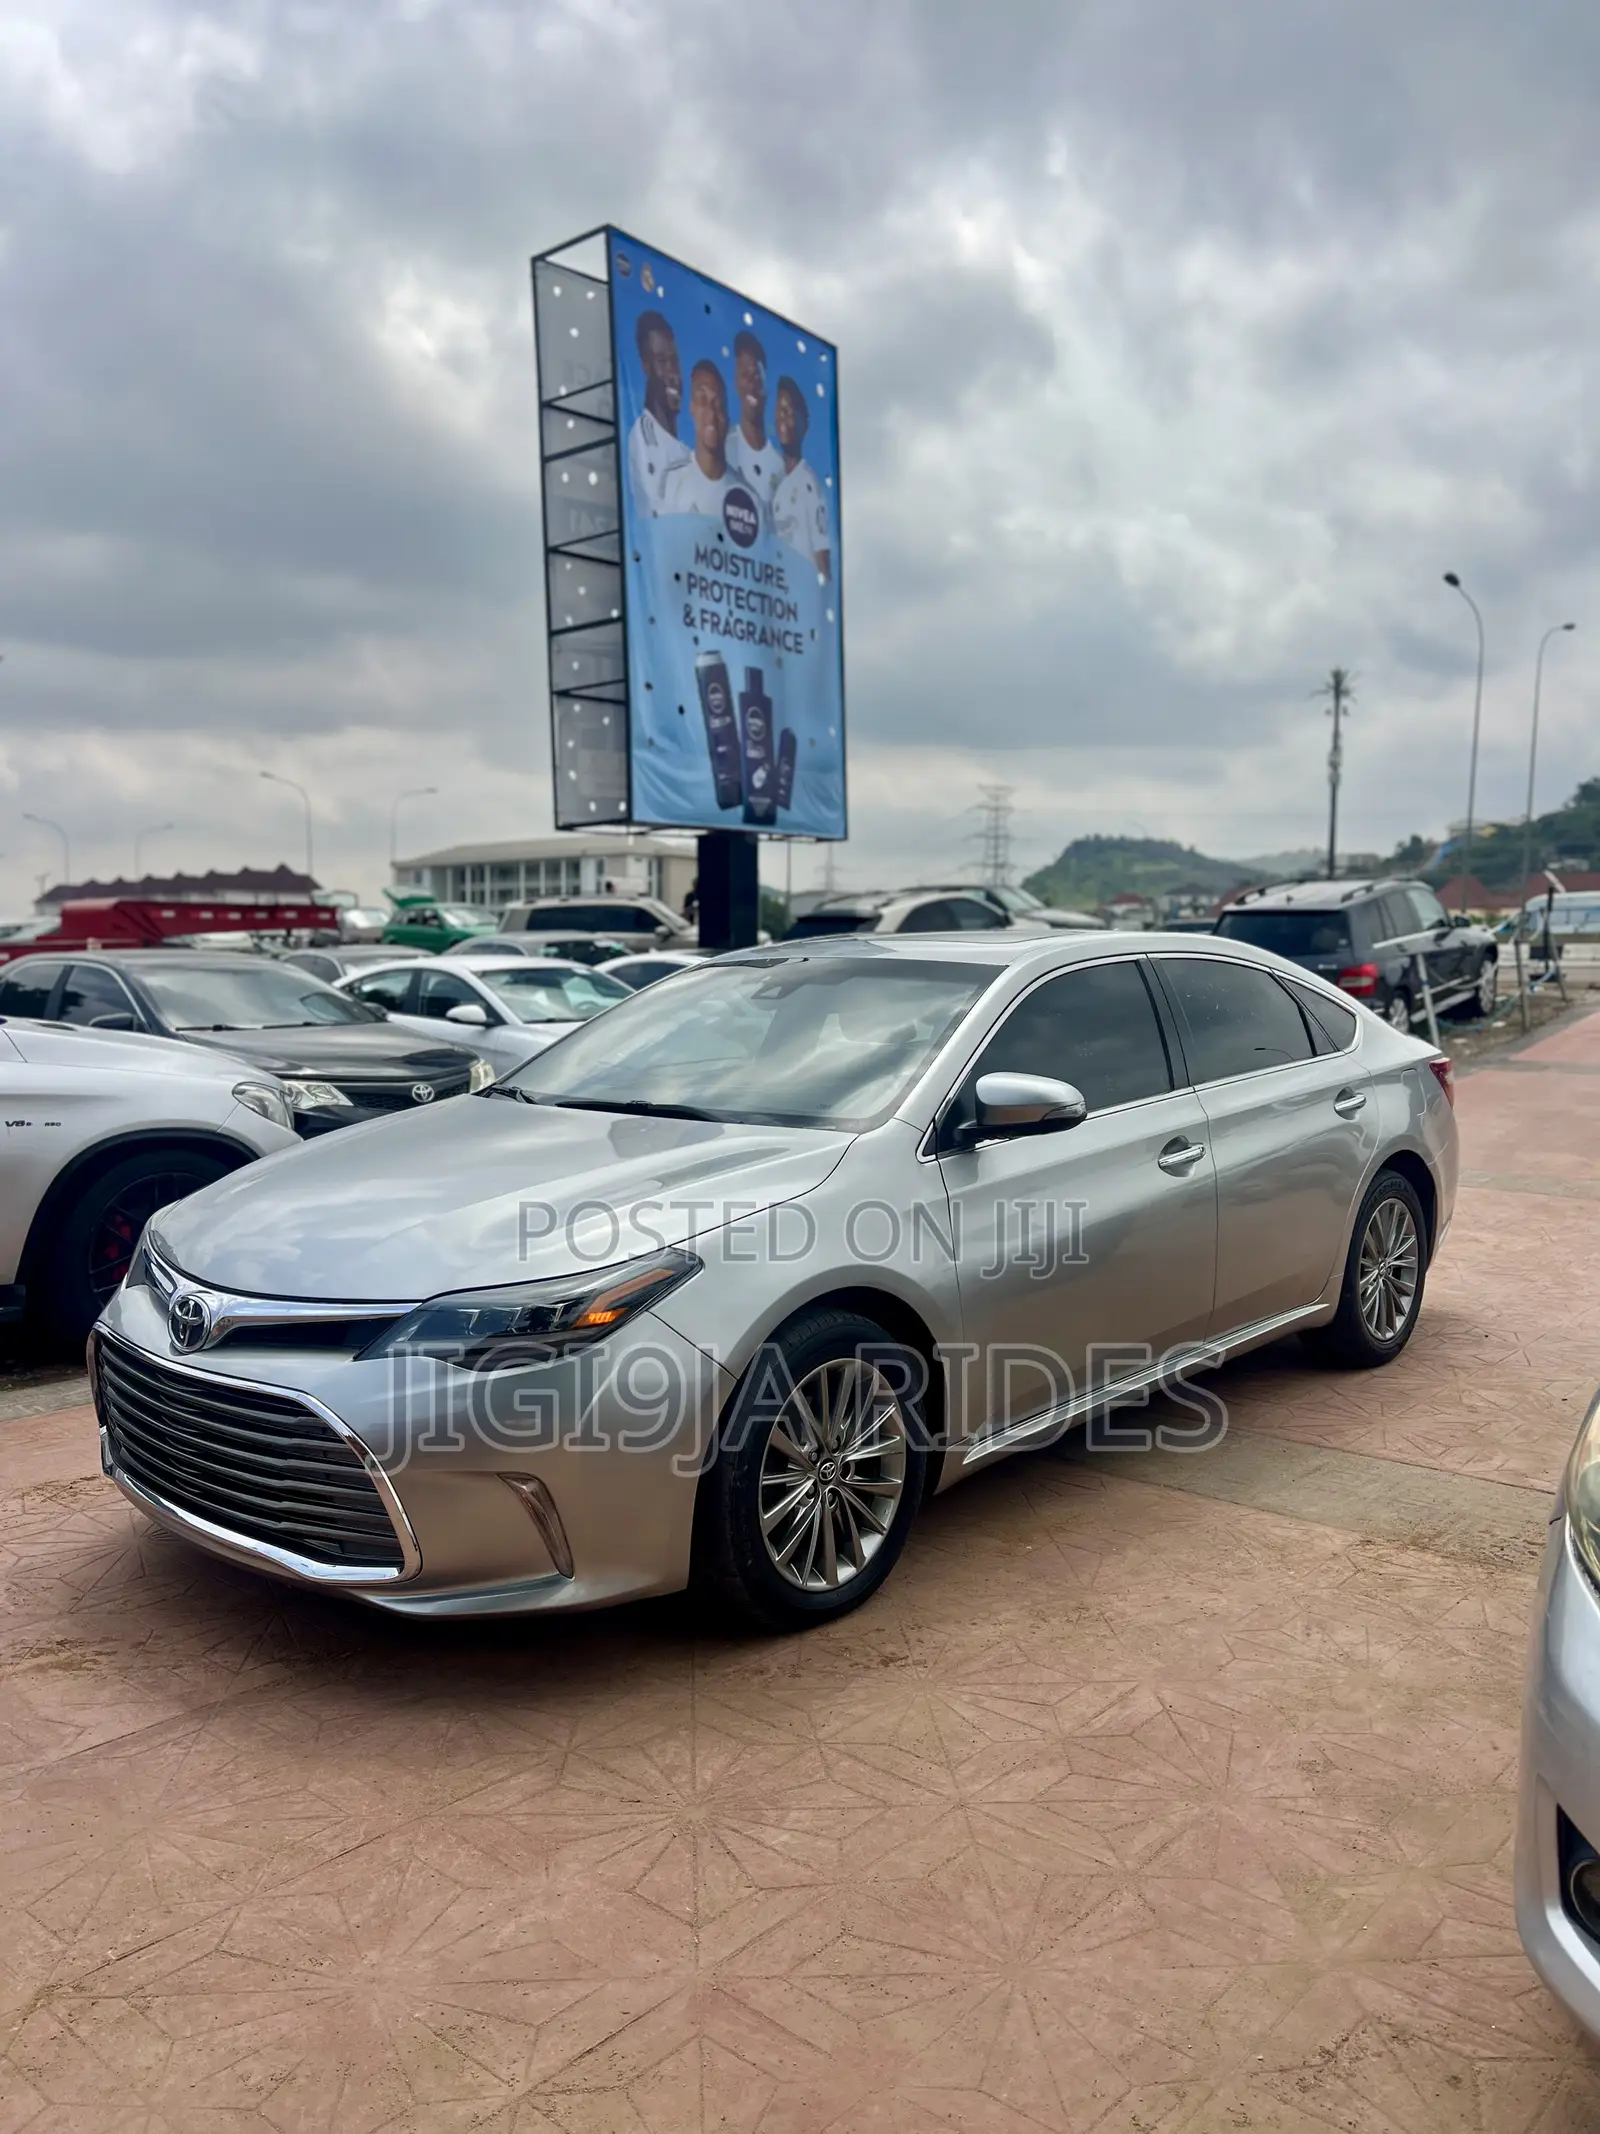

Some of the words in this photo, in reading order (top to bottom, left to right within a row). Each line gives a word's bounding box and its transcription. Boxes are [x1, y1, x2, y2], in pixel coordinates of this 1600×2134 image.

[725, 503, 757, 525] NIVEA
[694, 542, 789, 595] MOISTURE,
[686, 572, 798, 623] PROTECTION
[682, 603, 697, 629] &
[700, 609, 804, 655] FRAGRANCE
